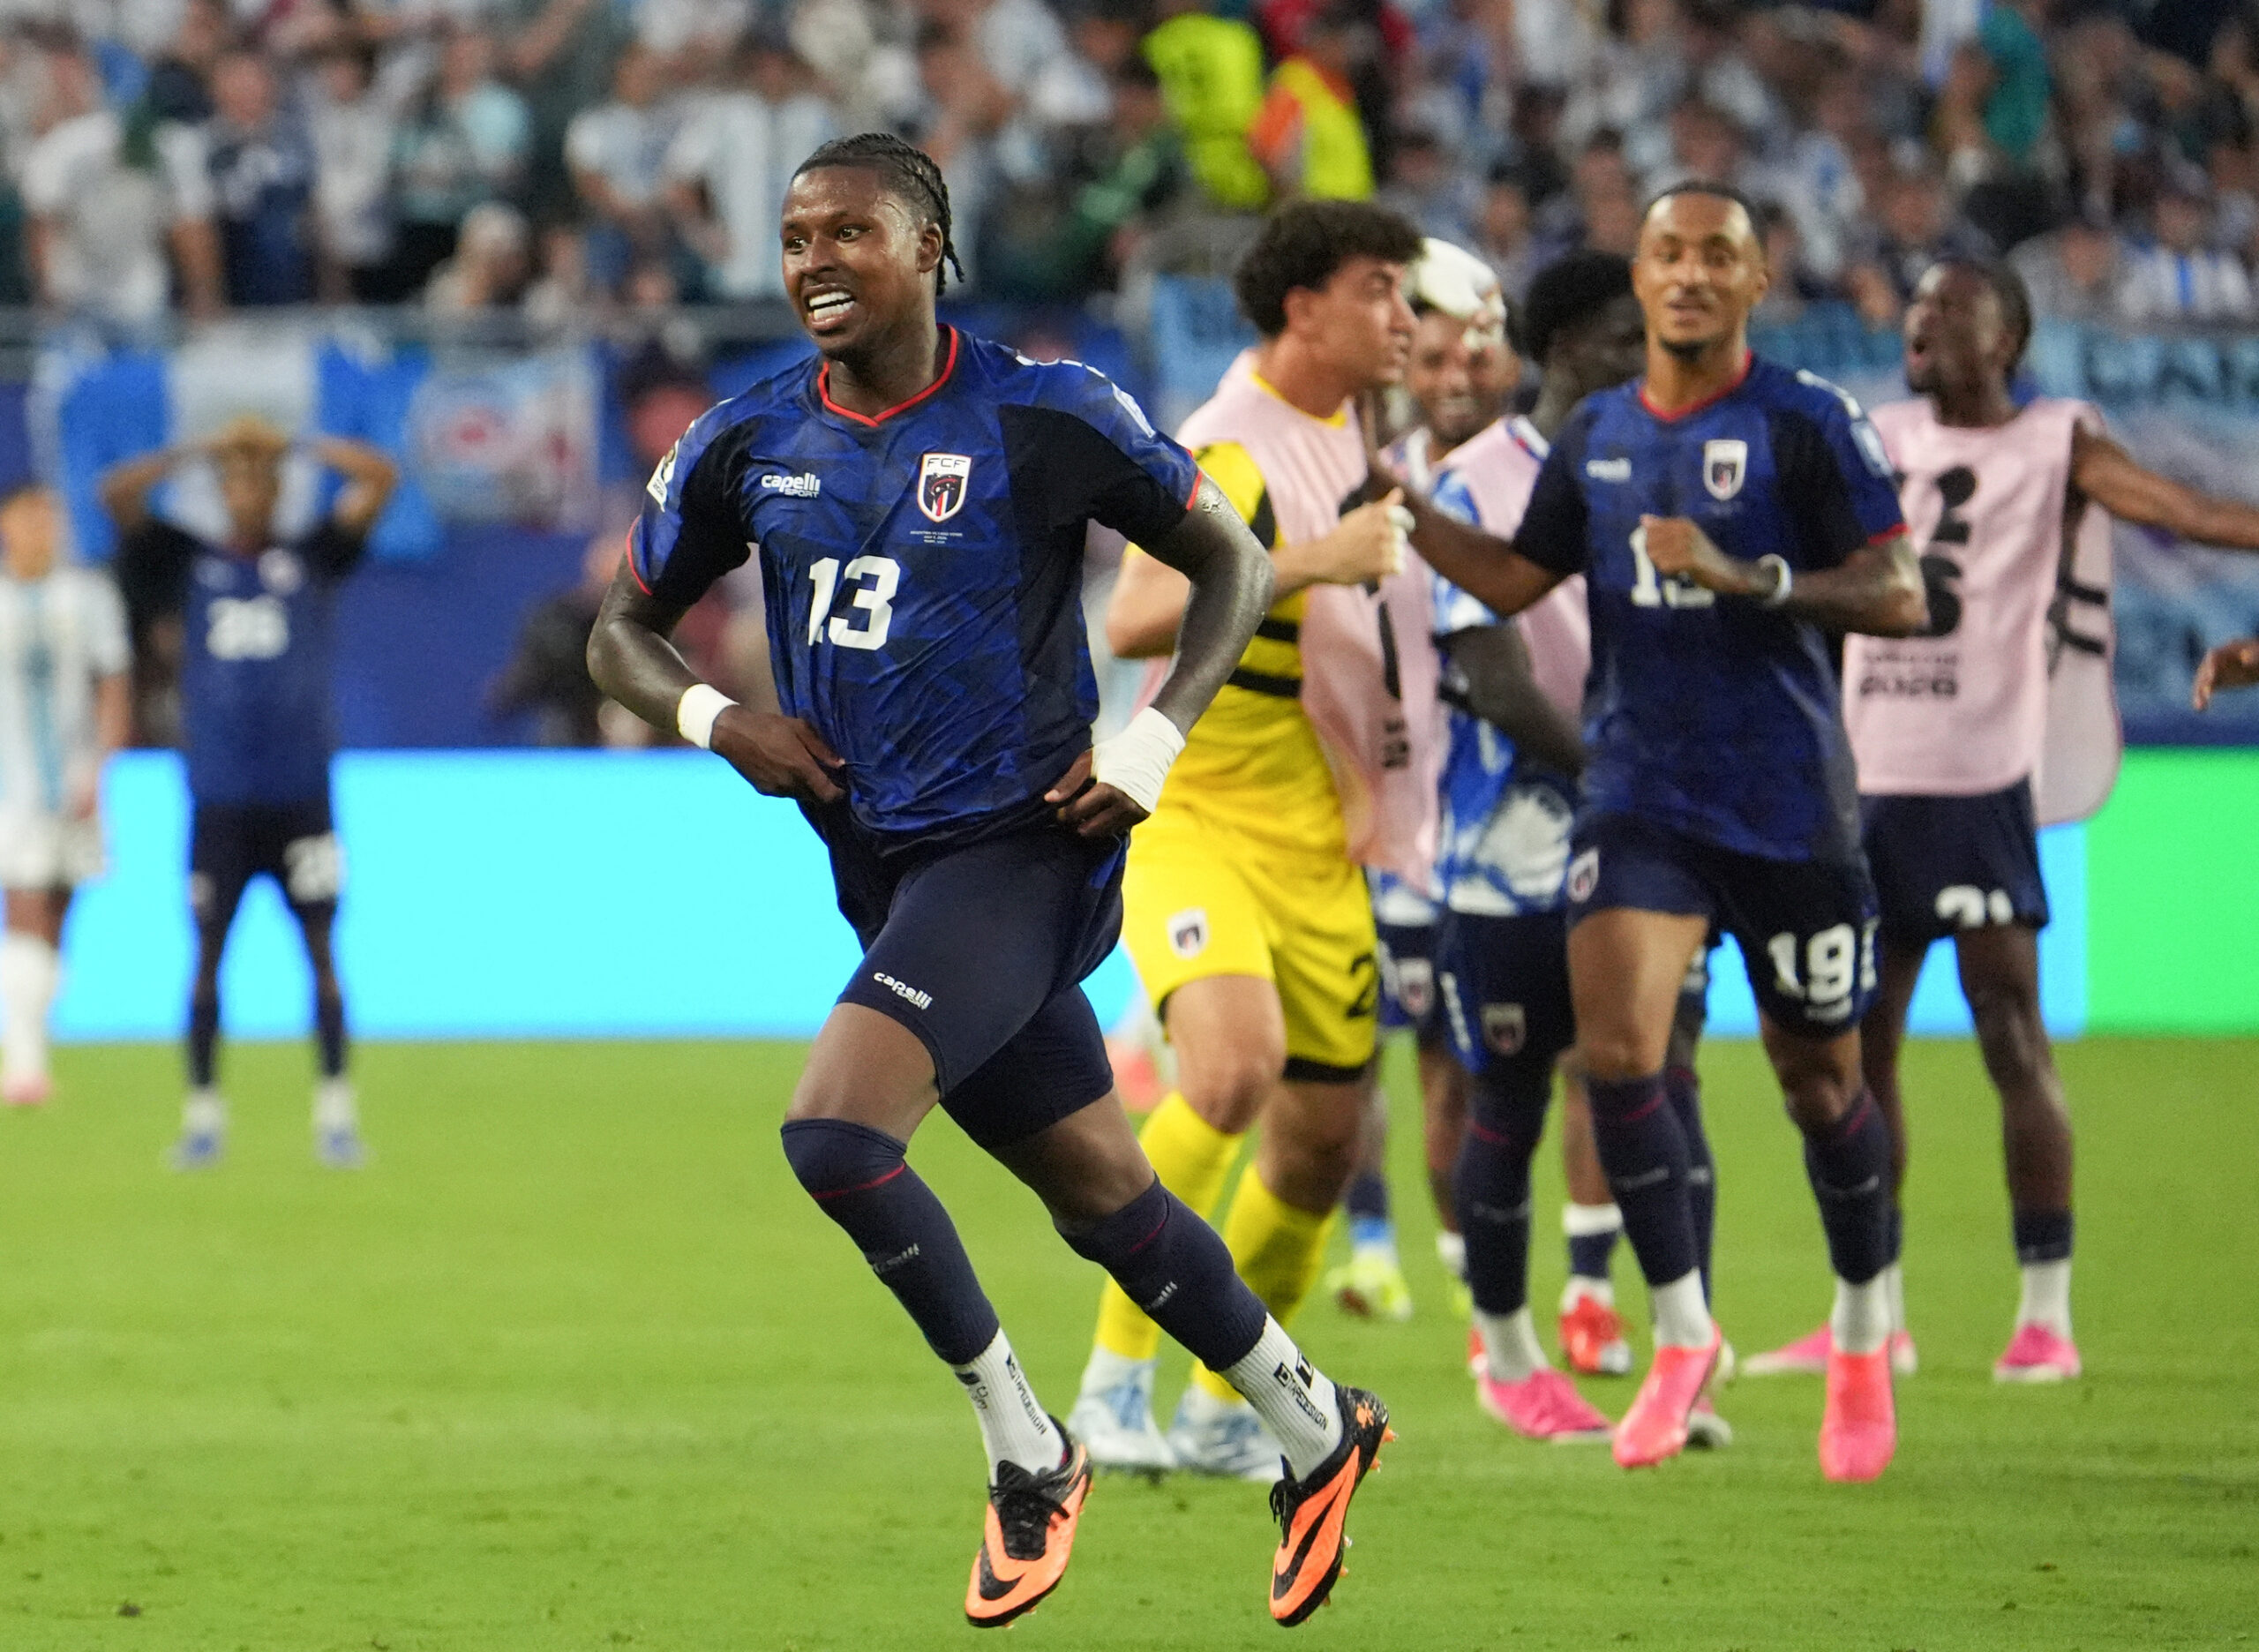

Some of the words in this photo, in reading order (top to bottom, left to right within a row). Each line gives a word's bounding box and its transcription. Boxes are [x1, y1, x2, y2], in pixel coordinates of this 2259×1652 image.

[927, 457, 966, 469] FCF
[762, 472, 821, 492] capelli
[784, 487, 819, 499] SPORT
[808, 555, 901, 651] 13
[1767, 922, 1855, 1006] 19
[873, 972, 933, 1008] capelli
